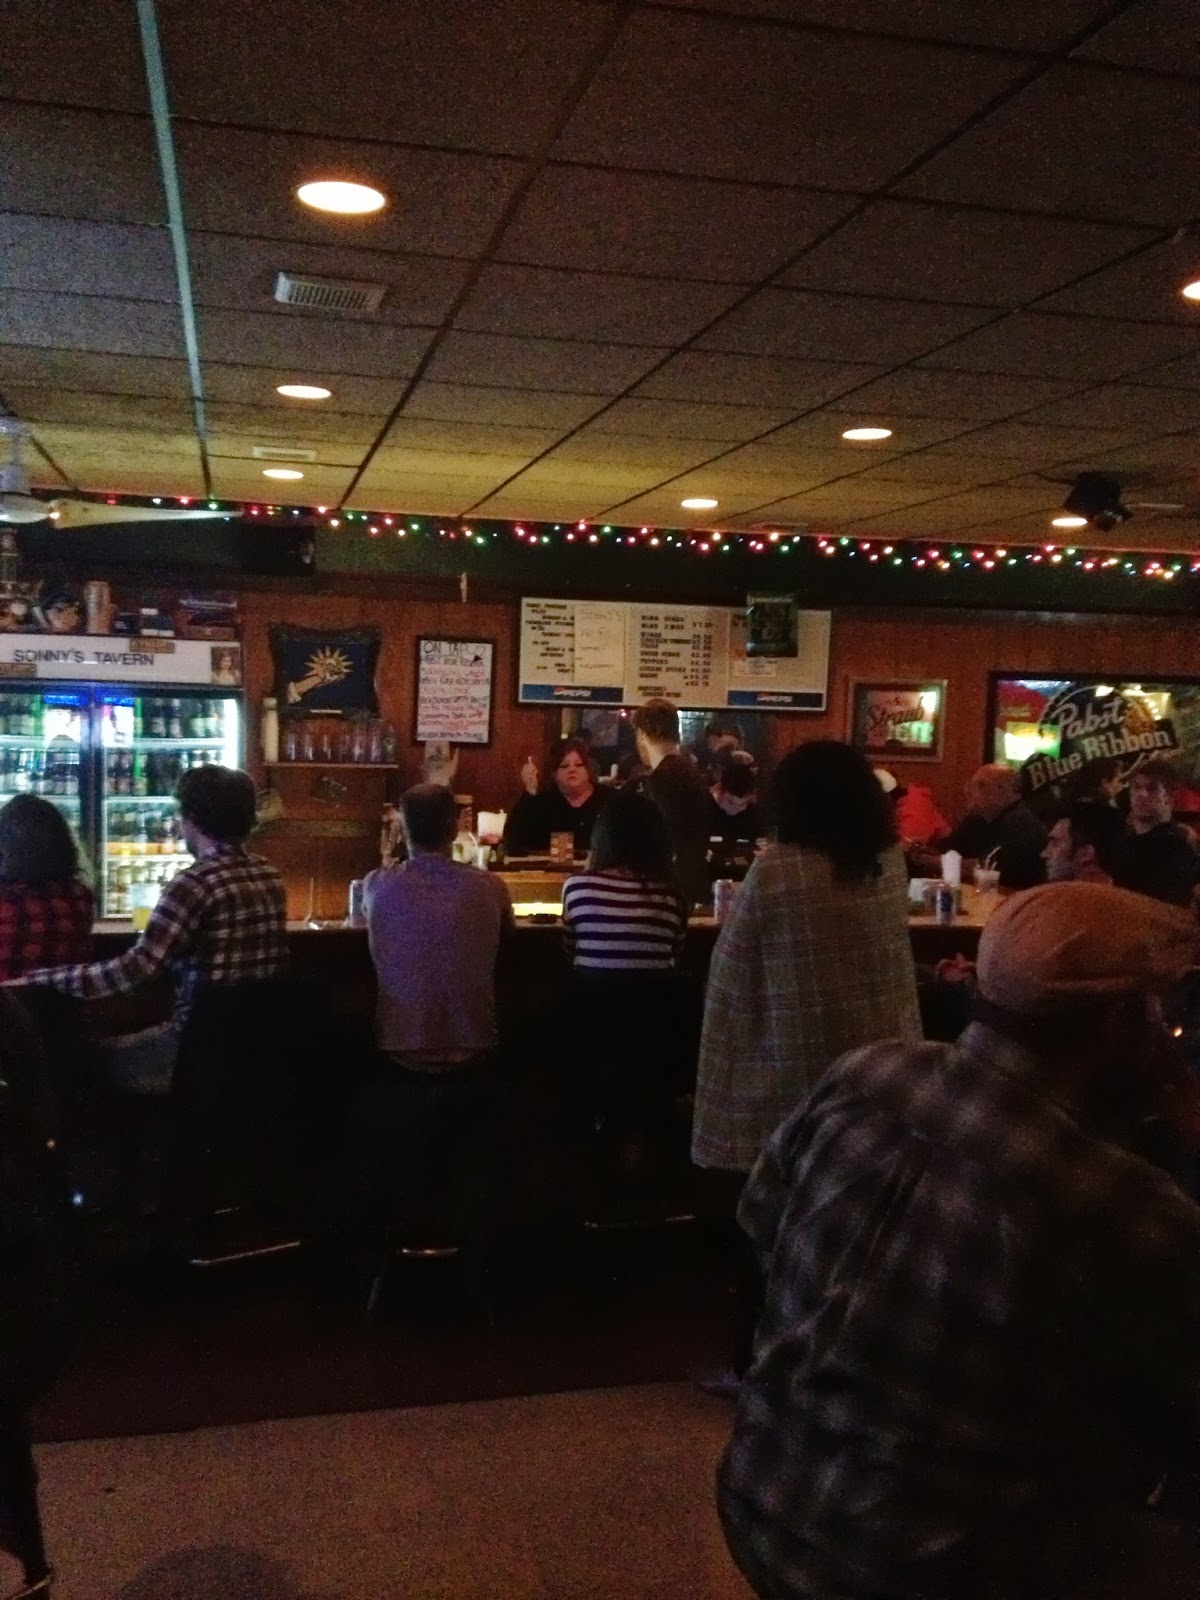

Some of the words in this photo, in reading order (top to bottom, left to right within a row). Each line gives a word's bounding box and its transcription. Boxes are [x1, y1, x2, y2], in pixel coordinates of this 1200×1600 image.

[14, 649, 84, 664] SONNY'S
[94, 651, 154, 666] TAVERN
[424, 641, 441, 654] ON
[1052, 698, 1124, 739] Pabst
[1029, 750, 1083, 791] Blue
[1081, 727, 1173, 763] Ribbon
